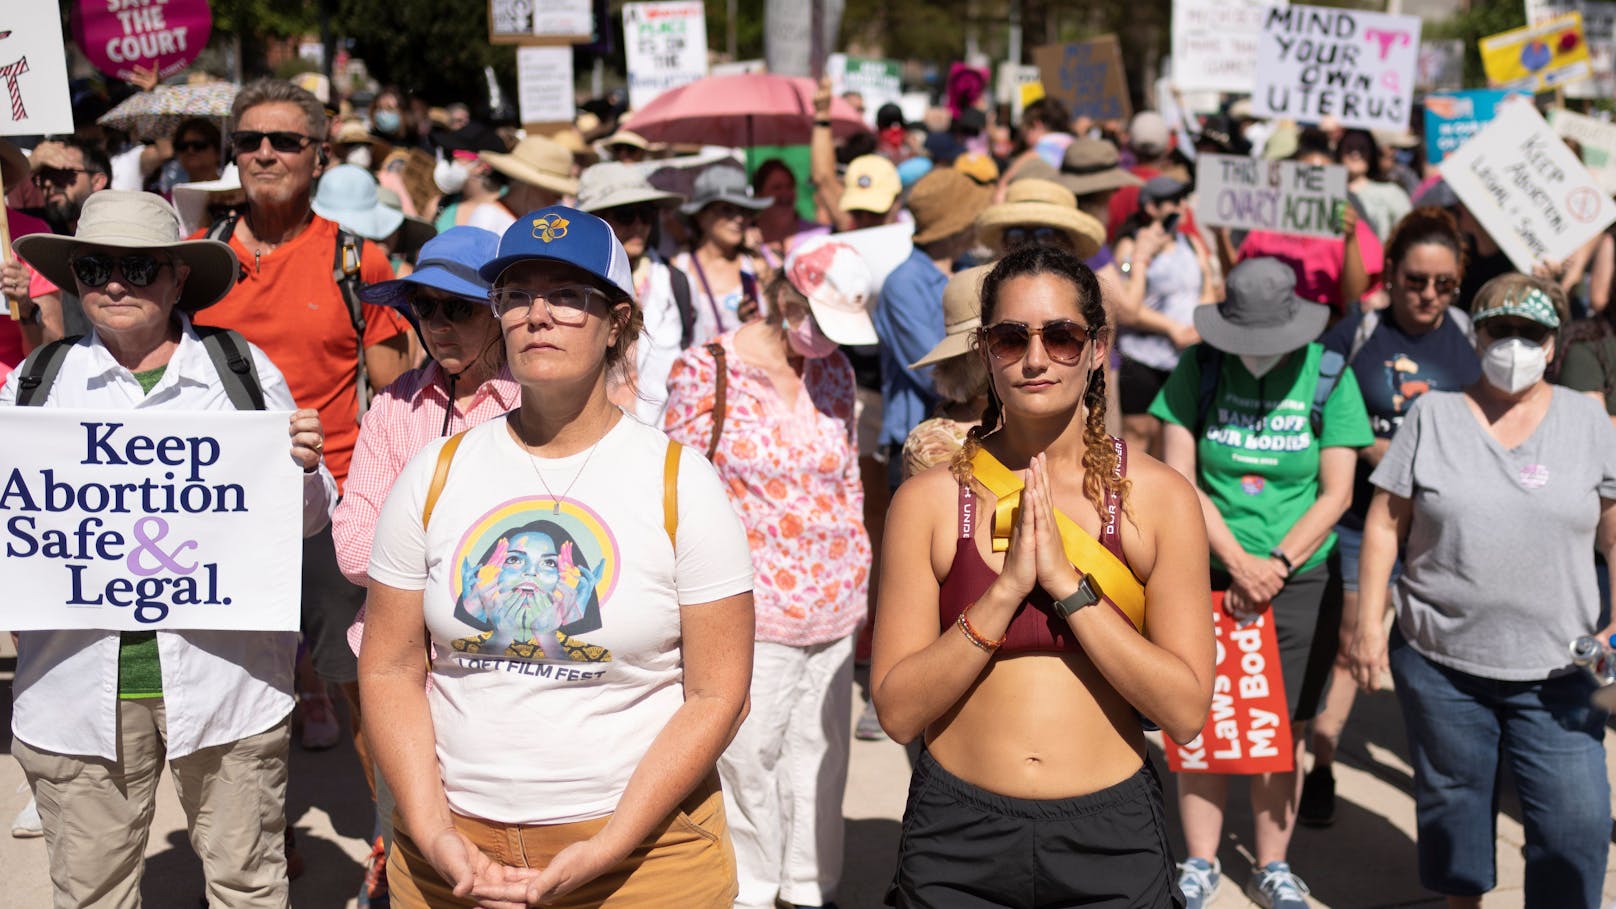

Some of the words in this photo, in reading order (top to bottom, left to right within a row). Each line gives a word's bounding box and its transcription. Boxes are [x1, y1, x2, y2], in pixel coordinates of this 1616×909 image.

[117, 4, 166, 35] THE
[1264, 7, 1357, 39] MIND
[106, 26, 187, 63] COURT
[1275, 35, 1361, 67] YOUR
[1267, 85, 1404, 122] UTERUS
[1219, 158, 1260, 186] THIS
[1294, 165, 1326, 192] ME
[1206, 425, 1243, 448] OUR
[1270, 414, 1307, 432] OFF
[80, 422, 221, 482] Keep
[0, 467, 249, 514] Abortion
[6, 515, 125, 561] Safe
[126, 515, 199, 577] &
[65, 562, 232, 624] Legal.
[506, 659, 554, 679] FILM
[554, 667, 607, 682] FEST
[1211, 674, 1242, 760] Laws
[1246, 707, 1281, 759] My
